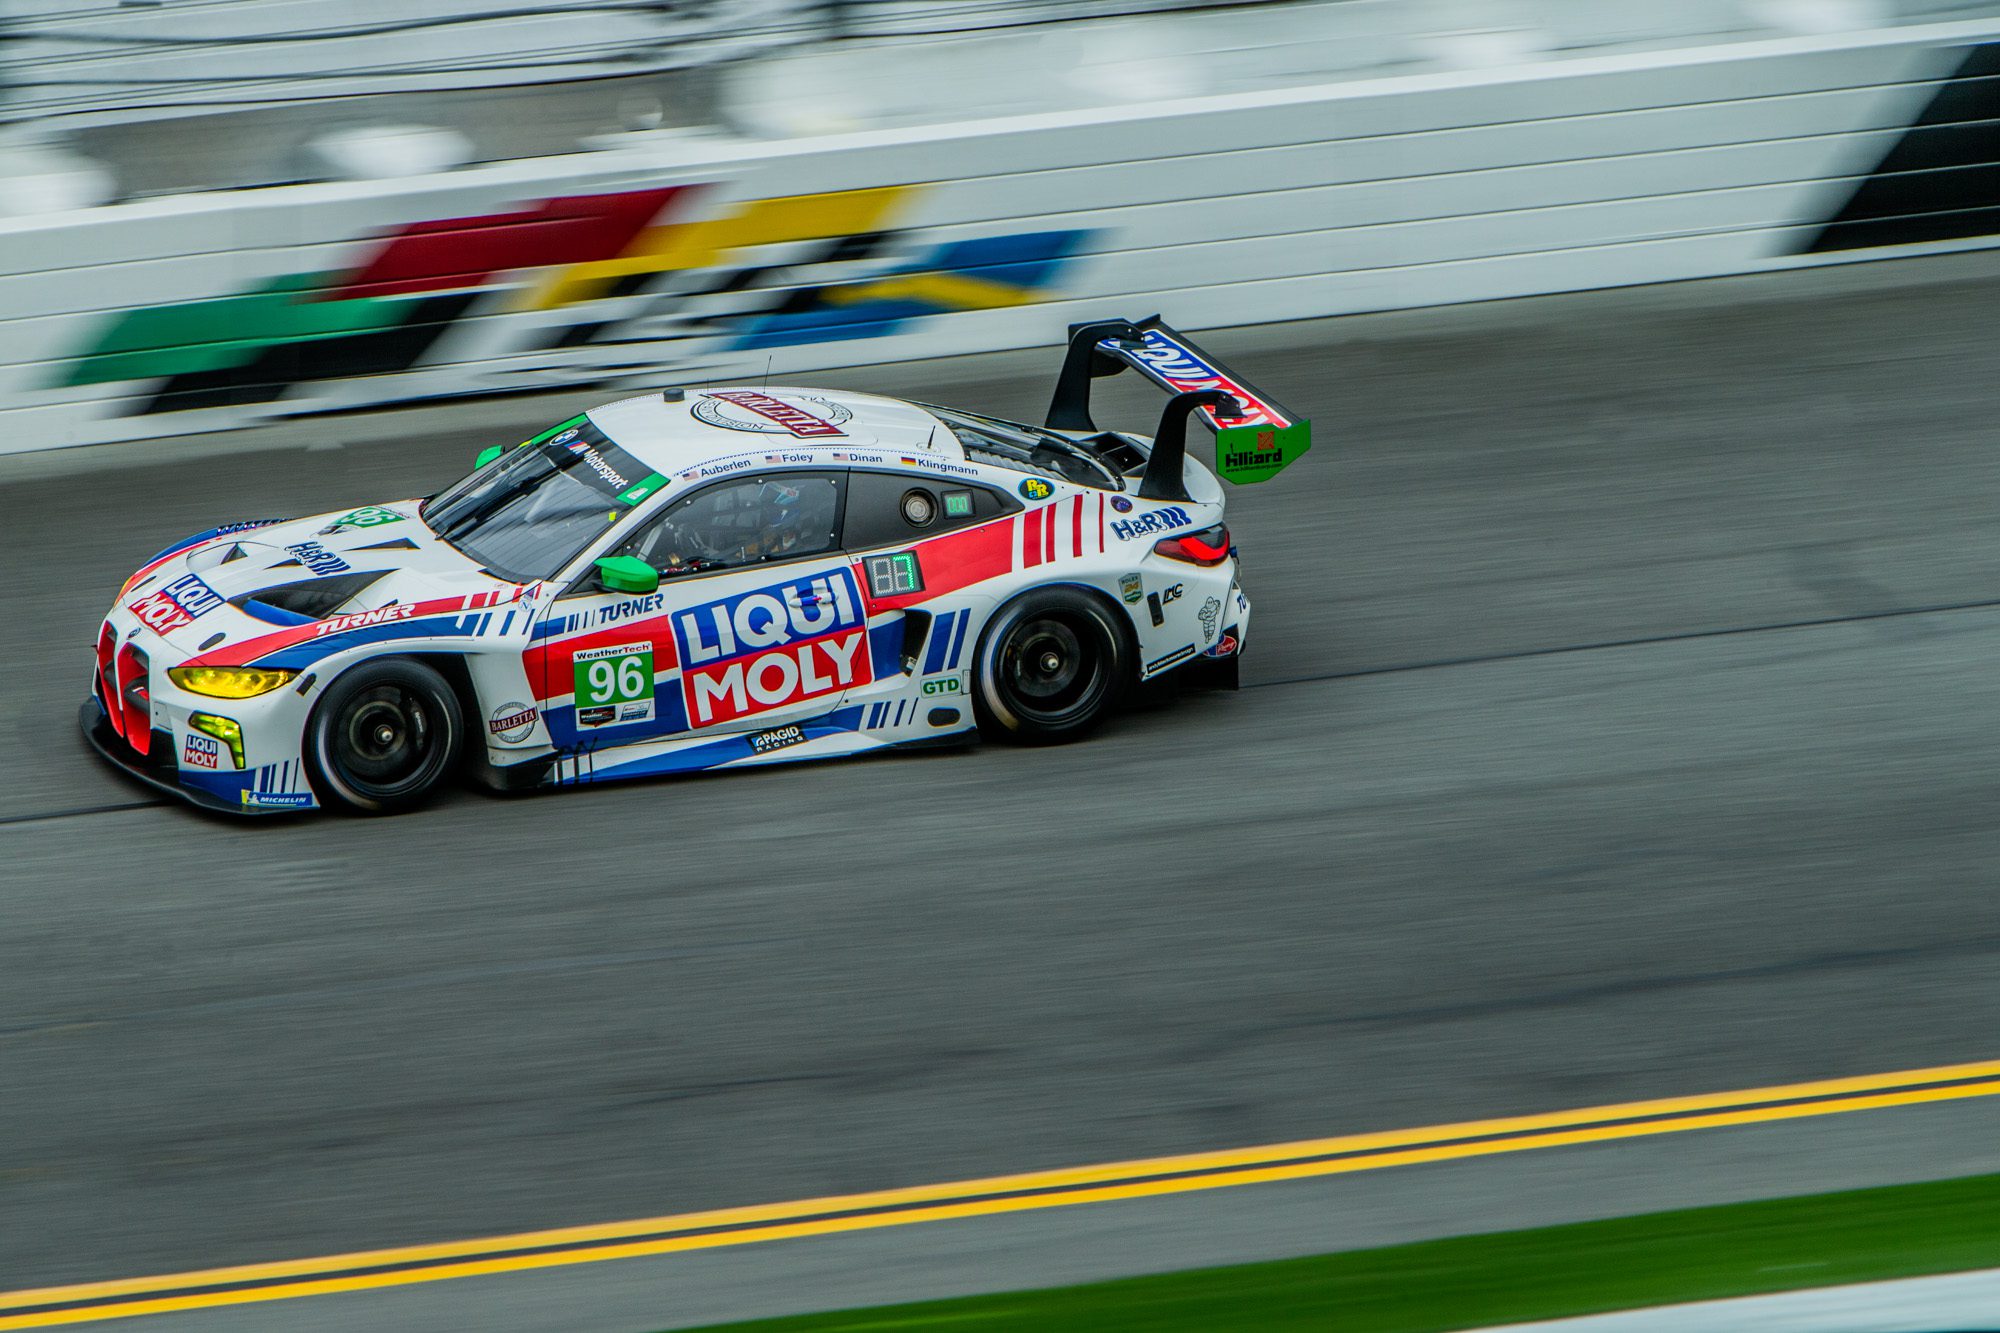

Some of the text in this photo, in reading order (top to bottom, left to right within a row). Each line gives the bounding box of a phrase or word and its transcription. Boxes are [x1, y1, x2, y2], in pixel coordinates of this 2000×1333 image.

[718, 392, 829, 434] BARLETTA
[700, 458, 751, 478] Auberlen
[782, 453, 814, 464] Foley
[849, 453, 883, 464] Dinan
[917, 458, 979, 477] Klingmann
[583, 448, 629, 490] Motorsport
[341, 508, 396, 526] 96
[1110, 512, 1168, 541] H&R
[285, 541, 337, 567] H&R
[165, 574, 223, 618] LIQUI
[131, 592, 191, 633] MOLY
[600, 593, 664, 625] TURNER
[681, 572, 855, 665] LIQUI
[315, 603, 416, 637] TURNER
[576, 643, 651, 660] WeatherTech
[588, 656, 644, 703] 96
[692, 631, 864, 722] MOLY
[922, 678, 960, 696] GTD
[491, 710, 535, 731] BARLETTA
[186, 736, 217, 754] LIQUI
[756, 736, 804, 753] RACING
[762, 726, 800, 744] PAGID
[185, 749, 217, 768] MOLY
[259, 796, 307, 804] MICHELIN
